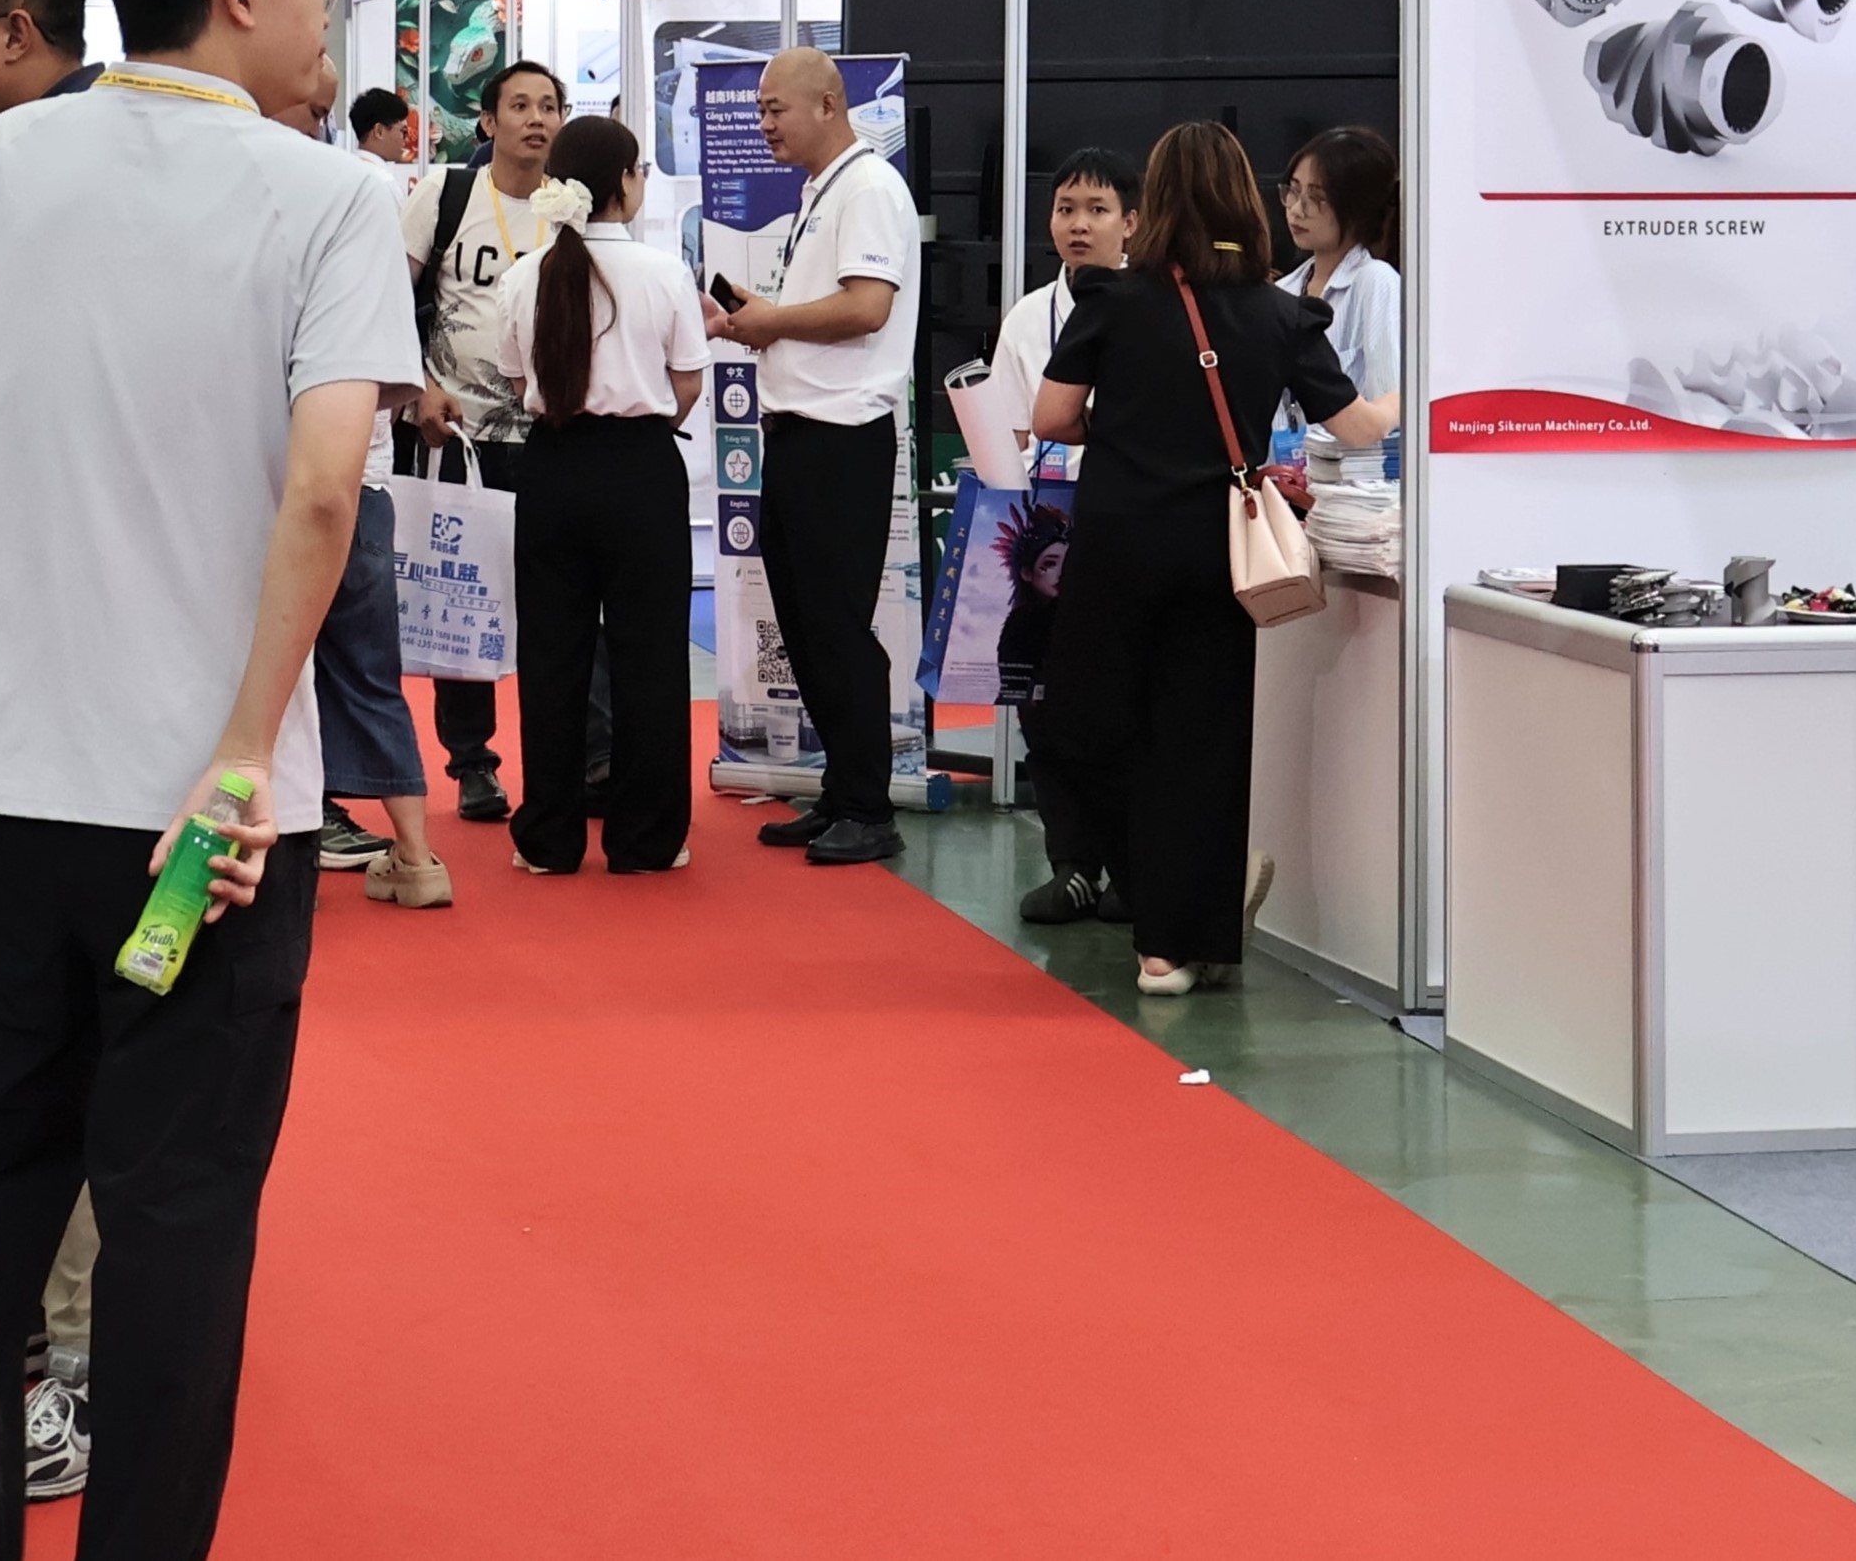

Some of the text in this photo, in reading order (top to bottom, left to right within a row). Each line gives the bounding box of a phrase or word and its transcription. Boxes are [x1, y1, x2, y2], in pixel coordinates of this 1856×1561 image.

[1604, 220, 1765, 236] EXTRUDER SCREW
[726, 367, 744, 378] 中文
[1449, 420, 1494, 434] Nanjing
[1498, 419, 1542, 432] Sikerun
[1546, 419, 1604, 433] Machinery
[730, 499, 749, 509] English
